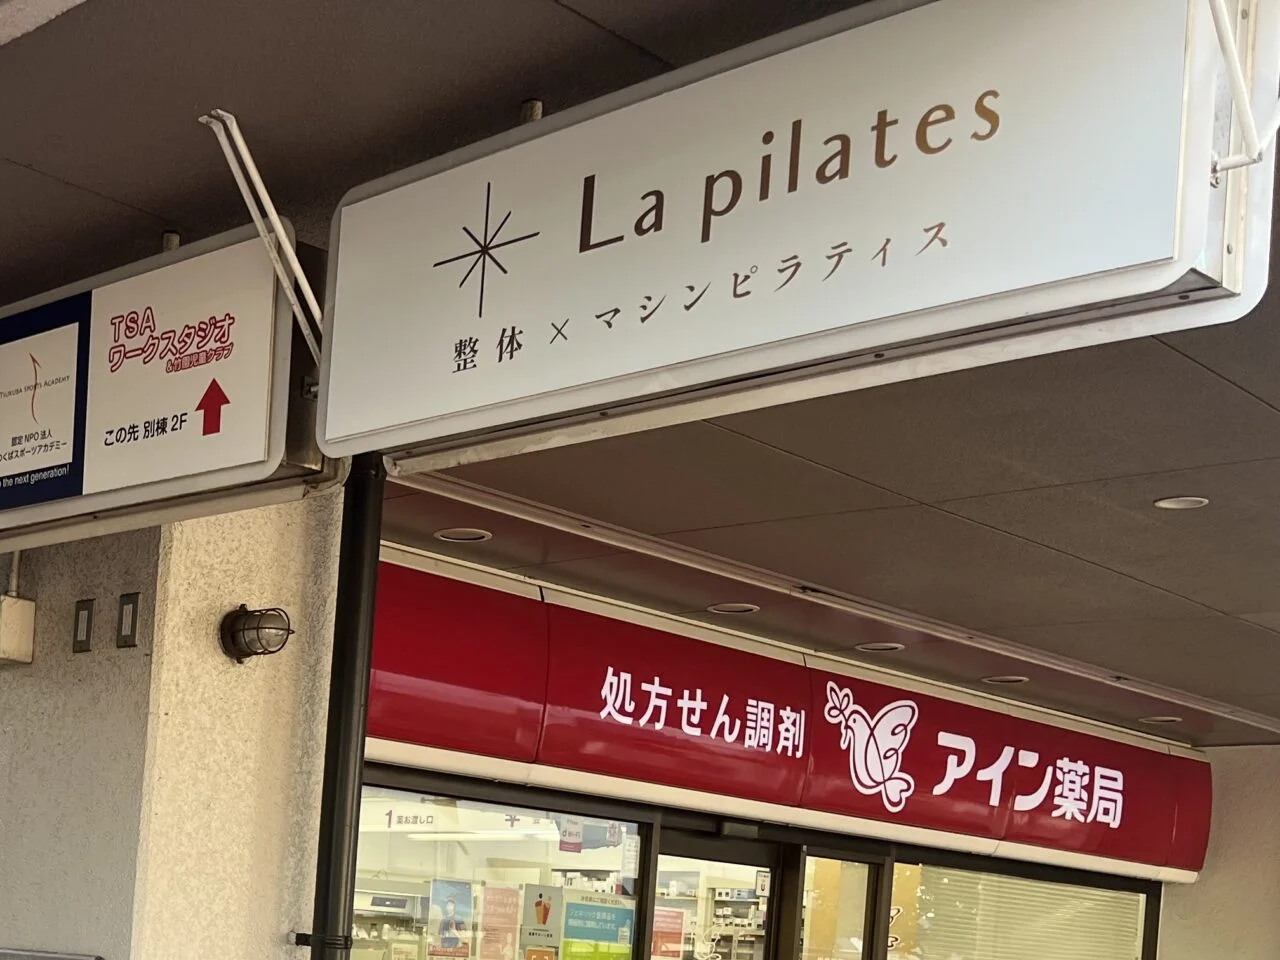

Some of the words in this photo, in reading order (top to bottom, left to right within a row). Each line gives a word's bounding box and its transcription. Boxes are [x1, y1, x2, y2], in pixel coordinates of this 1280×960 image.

[578, 173, 666, 254] La
[700, 88, 1002, 244] pilates
[110, 306, 156, 343] TSA
[108, 313, 236, 373] ワークスタジオ
[43, 375, 70, 388] ACADEMY
[24, 431, 39, 443] NPO
[40, 428, 53, 439] 法人
[103, 424, 139, 447] この先
[142, 416, 168, 440] 別棟
[170, 412, 188, 432] 2F
[3, 478, 13, 487] the
[14, 474, 30, 485] next
[30, 464, 70, 485] generation!
[599, 665, 806, 759] 処方せん調剤
[932, 731, 1124, 829] アイン薬局
[384, 809, 393, 829] 1
